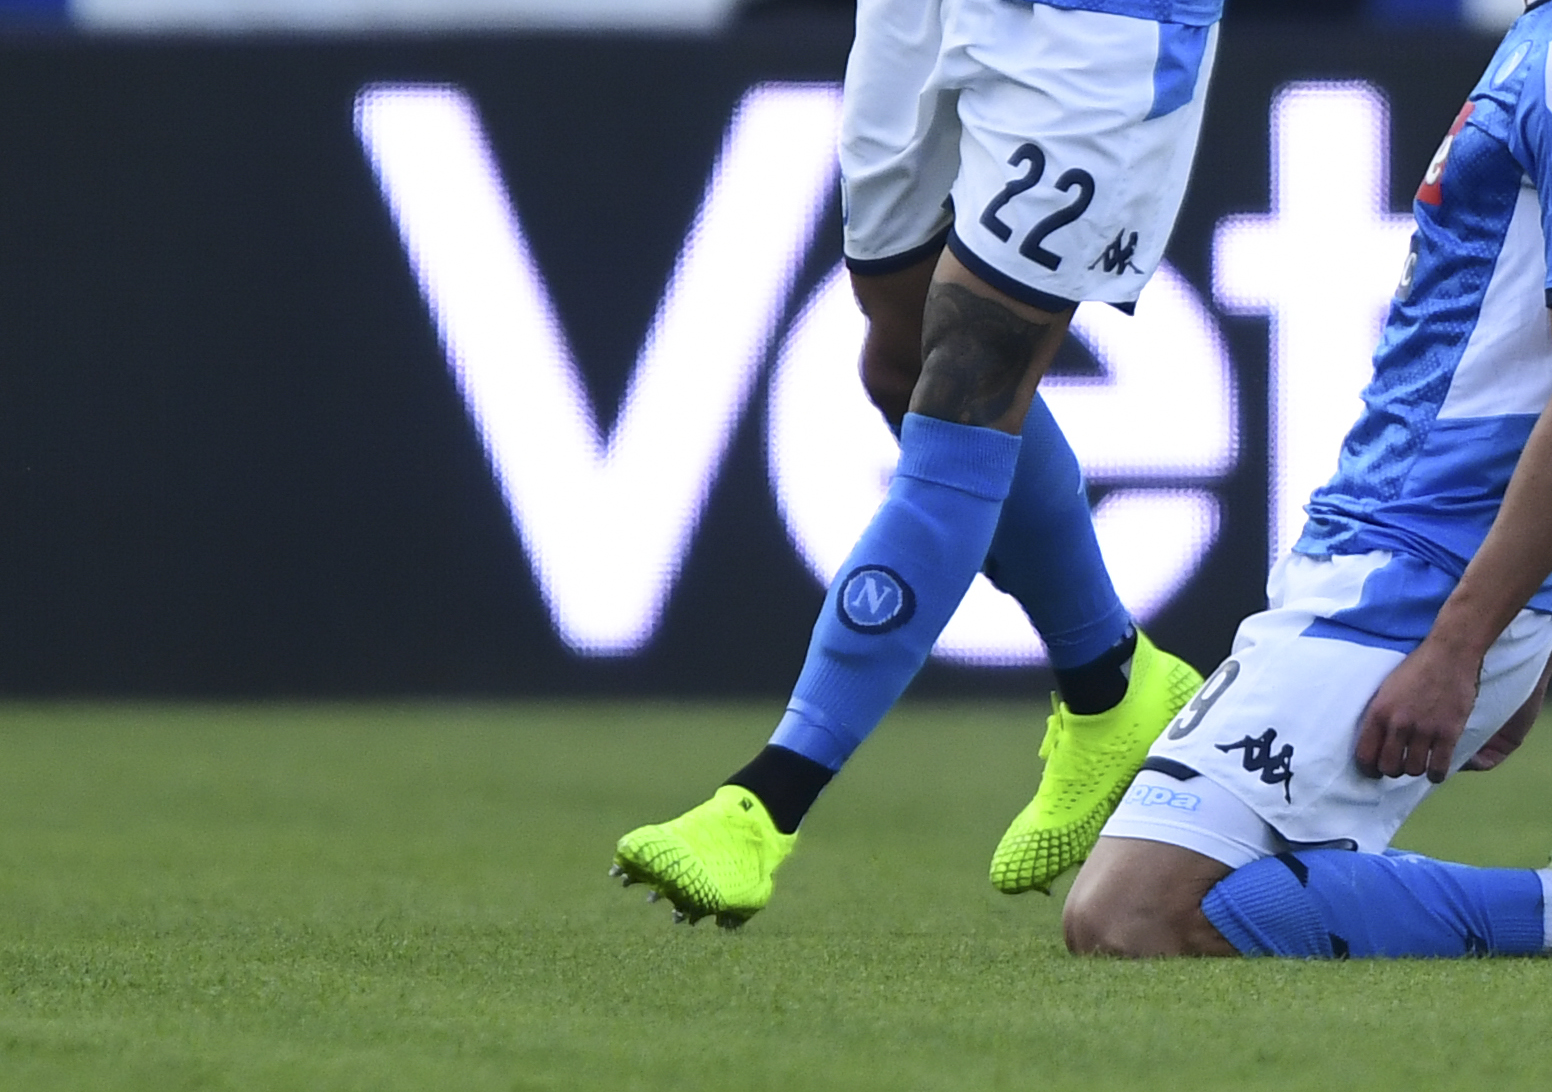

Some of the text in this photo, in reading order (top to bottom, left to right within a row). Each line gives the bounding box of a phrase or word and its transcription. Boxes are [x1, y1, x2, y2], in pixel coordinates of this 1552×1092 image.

[979, 142, 1096, 272] 22
[852, 577, 892, 614] N
[1167, 659, 1241, 741] 9
[1125, 784, 1201, 811] ppa
